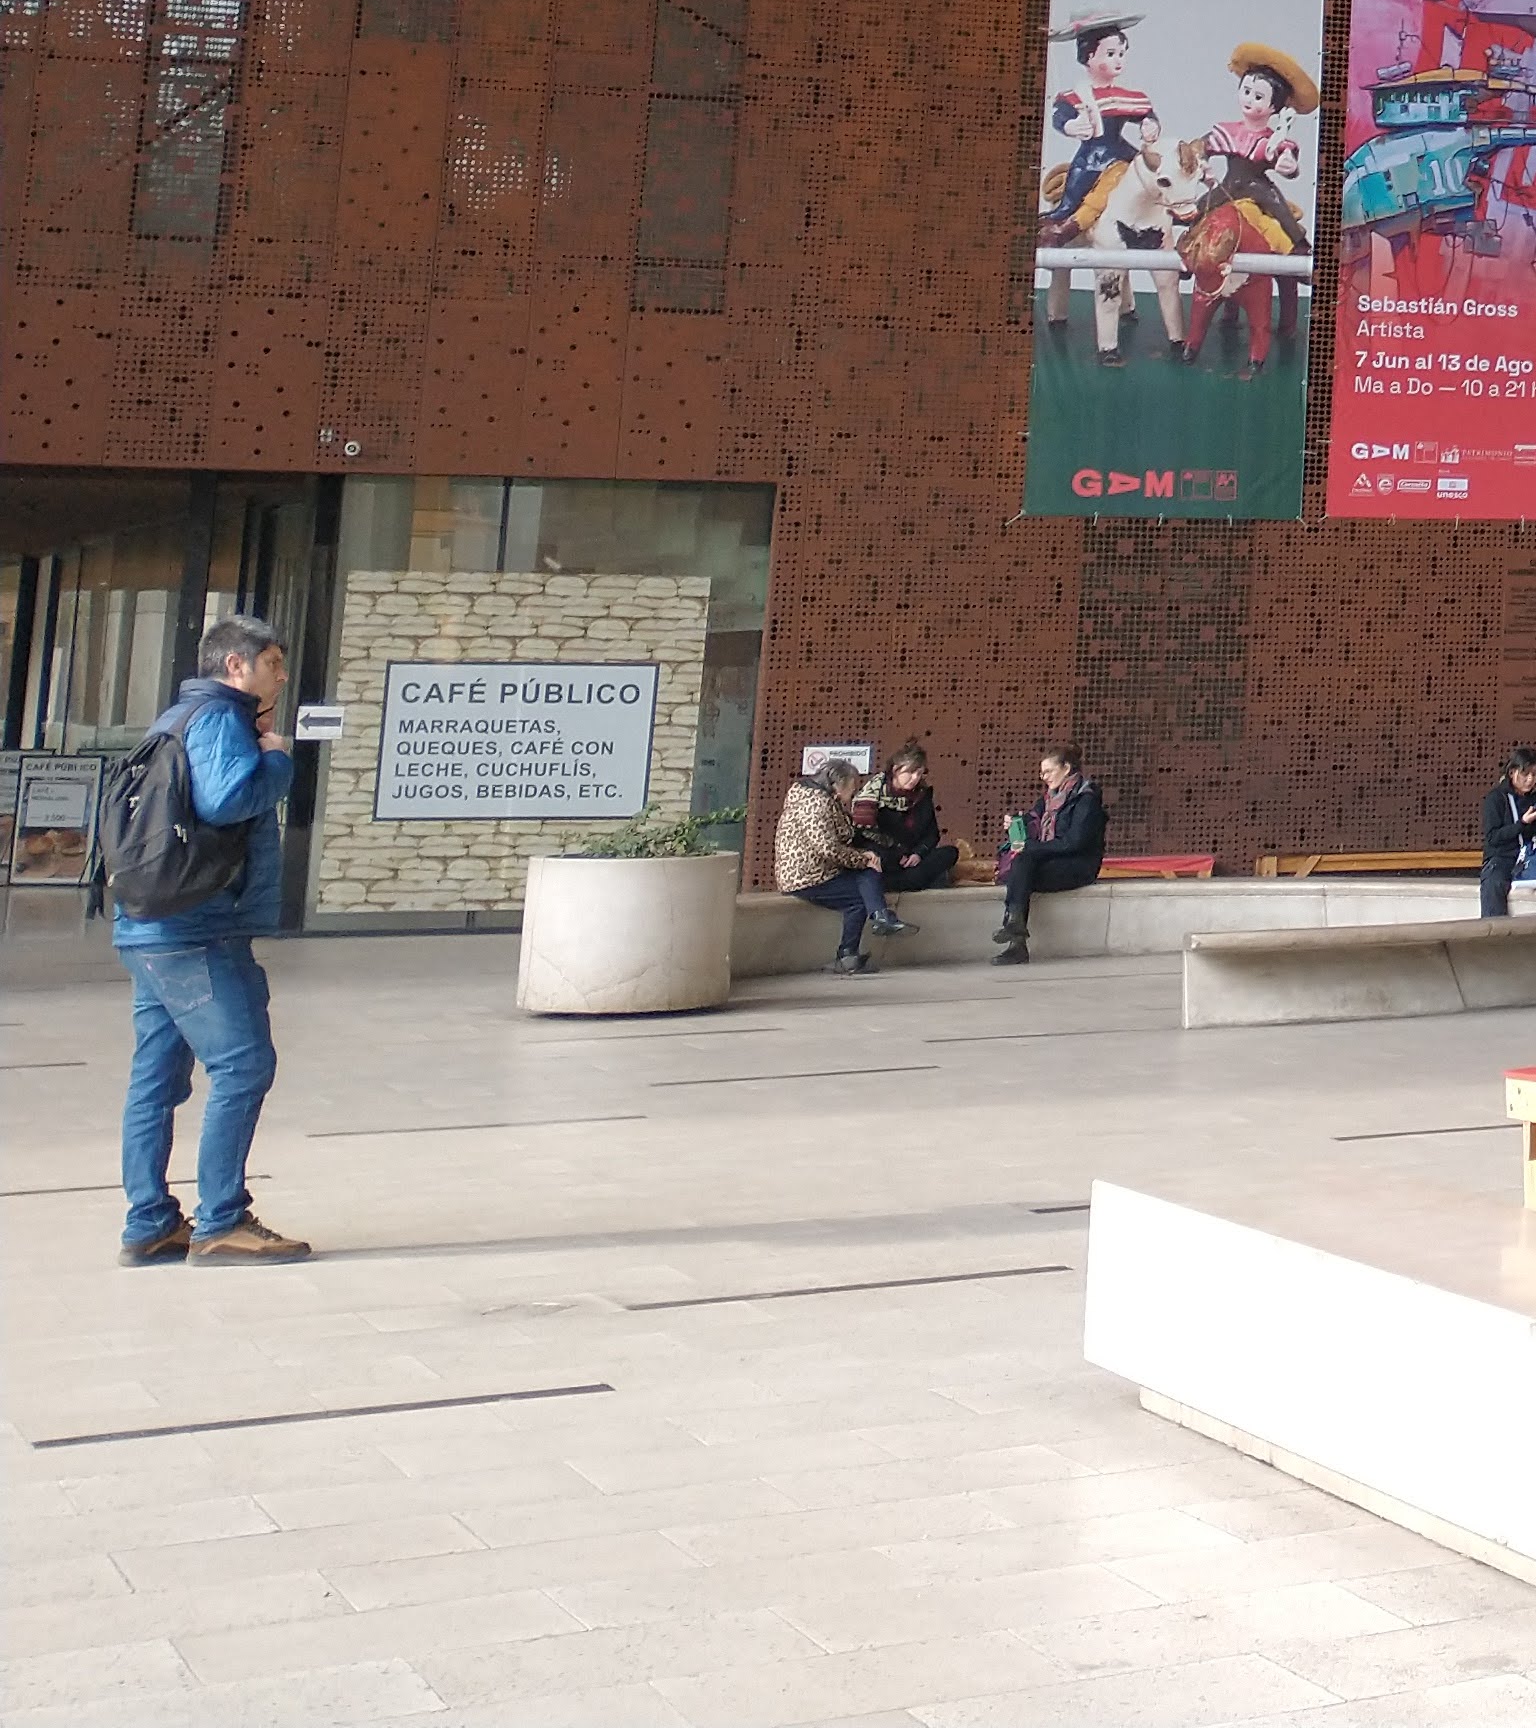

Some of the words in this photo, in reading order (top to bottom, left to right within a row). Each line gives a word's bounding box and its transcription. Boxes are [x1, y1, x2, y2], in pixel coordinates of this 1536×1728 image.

[1429, 157, 1465, 197] 10
[1358, 295, 1458, 315] Sebastián
[1463, 299, 1518, 317] Gross
[1356, 320, 1425, 339] Artista
[1355, 351, 1368, 368] 7
[1372, 351, 1409, 370] Jun
[1415, 353, 1432, 370] al
[1438, 354, 1460, 371] 13
[1465, 354, 1490, 372] de
[1494, 356, 1533, 377] Ago
[1354, 375, 1384, 394] Ma
[1390, 382, 1401, 394] a
[1407, 378, 1433, 395] Do
[1461, 379, 1483, 397] 10
[1488, 385, 1499, 397] a
[1505, 380, 1526, 398] 21
[1351, 442, 1410, 460] GAM
[1072, 468, 1175, 498] GAM
[401, 678, 487, 704] CAFÉ
[500, 678, 640, 705] PÚBLICO
[398, 720, 561, 736] MARRAQUETAS,
[397, 741, 503, 757] QUEQUES,
[511, 738, 564, 755] CAFÉ
[571, 741, 614, 755] CON
[394, 762, 468, 779] LECHE,
[476, 759, 596, 778] CUCHUFLÍS,
[392, 784, 468, 801] JUGOS,
[476, 784, 571, 800] BEBIDAS,
[578, 784, 623, 798] ETC.
